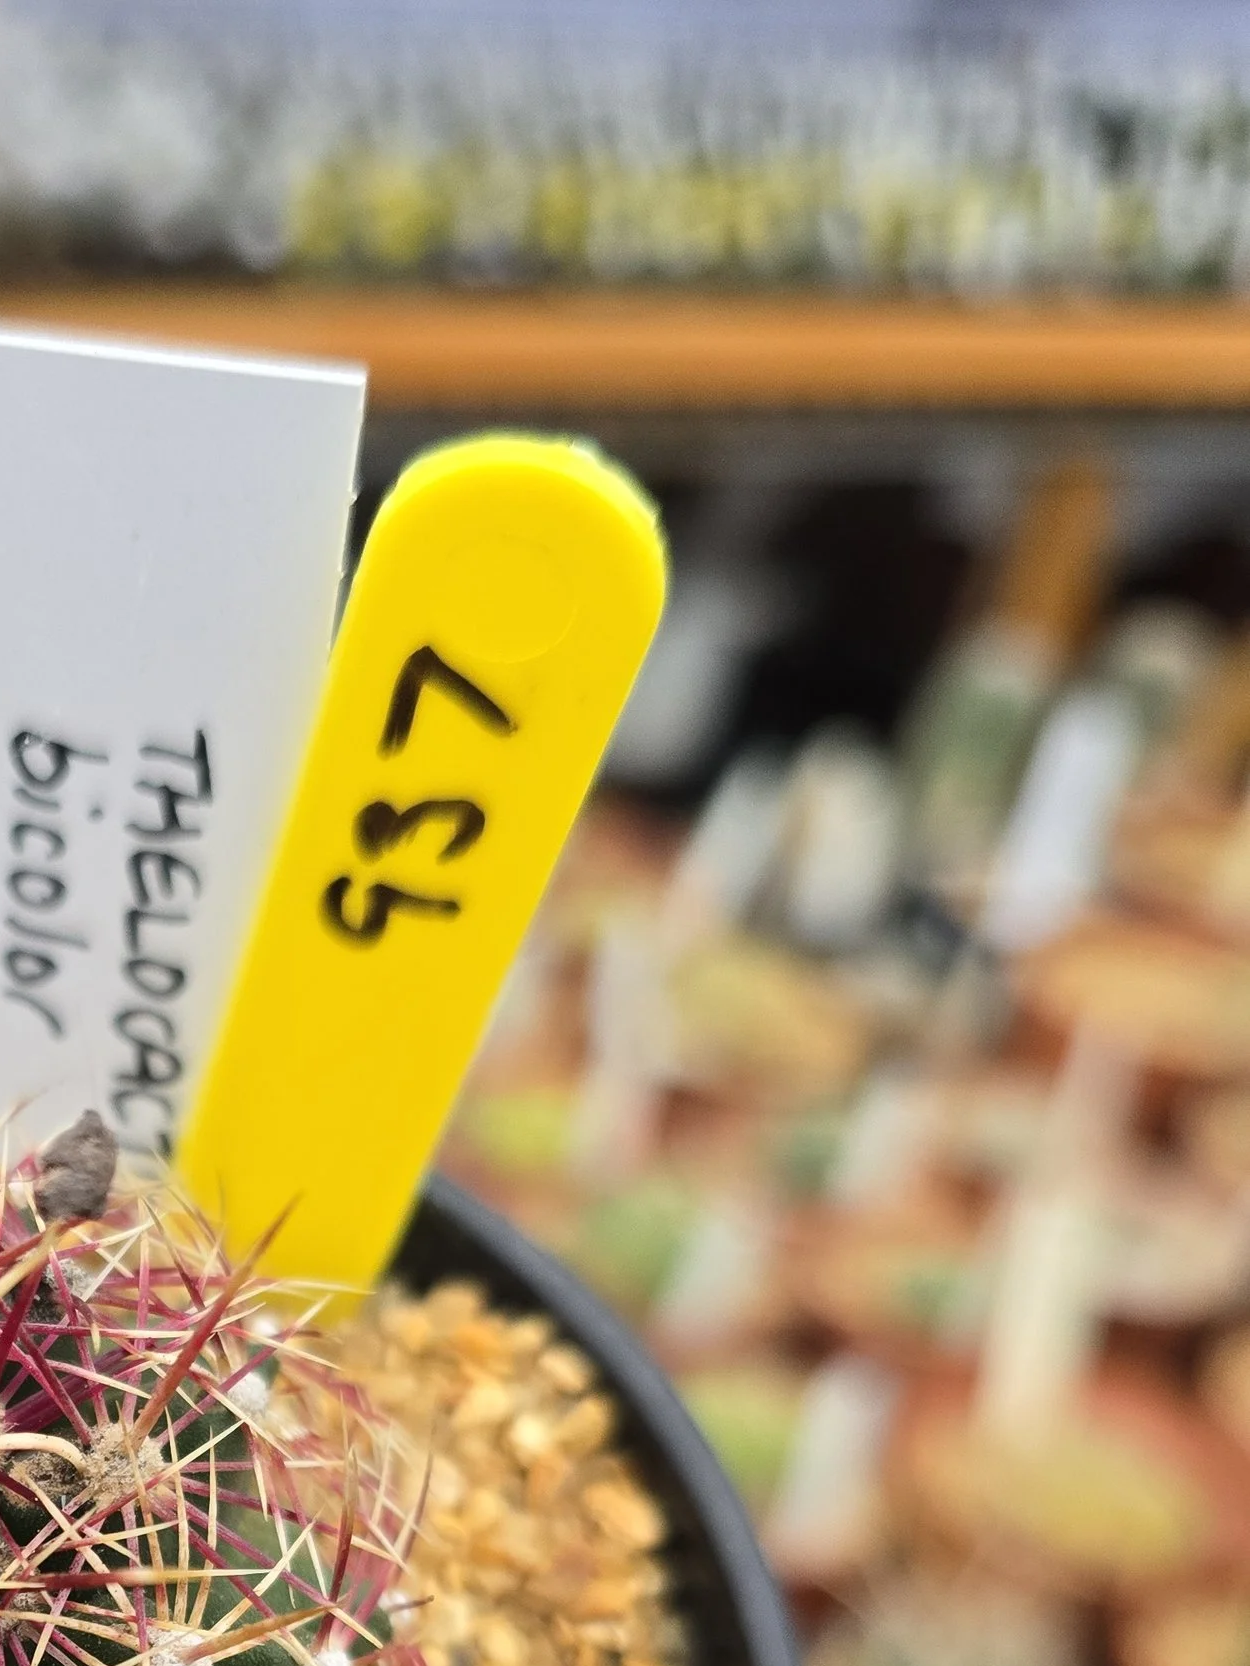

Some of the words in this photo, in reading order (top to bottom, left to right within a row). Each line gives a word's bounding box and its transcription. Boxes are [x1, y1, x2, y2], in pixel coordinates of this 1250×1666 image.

[2, 727, 109, 1039] bicolor
[110, 727, 215, 1172] THELOCACT
[320, 644, 518, 948] 937
